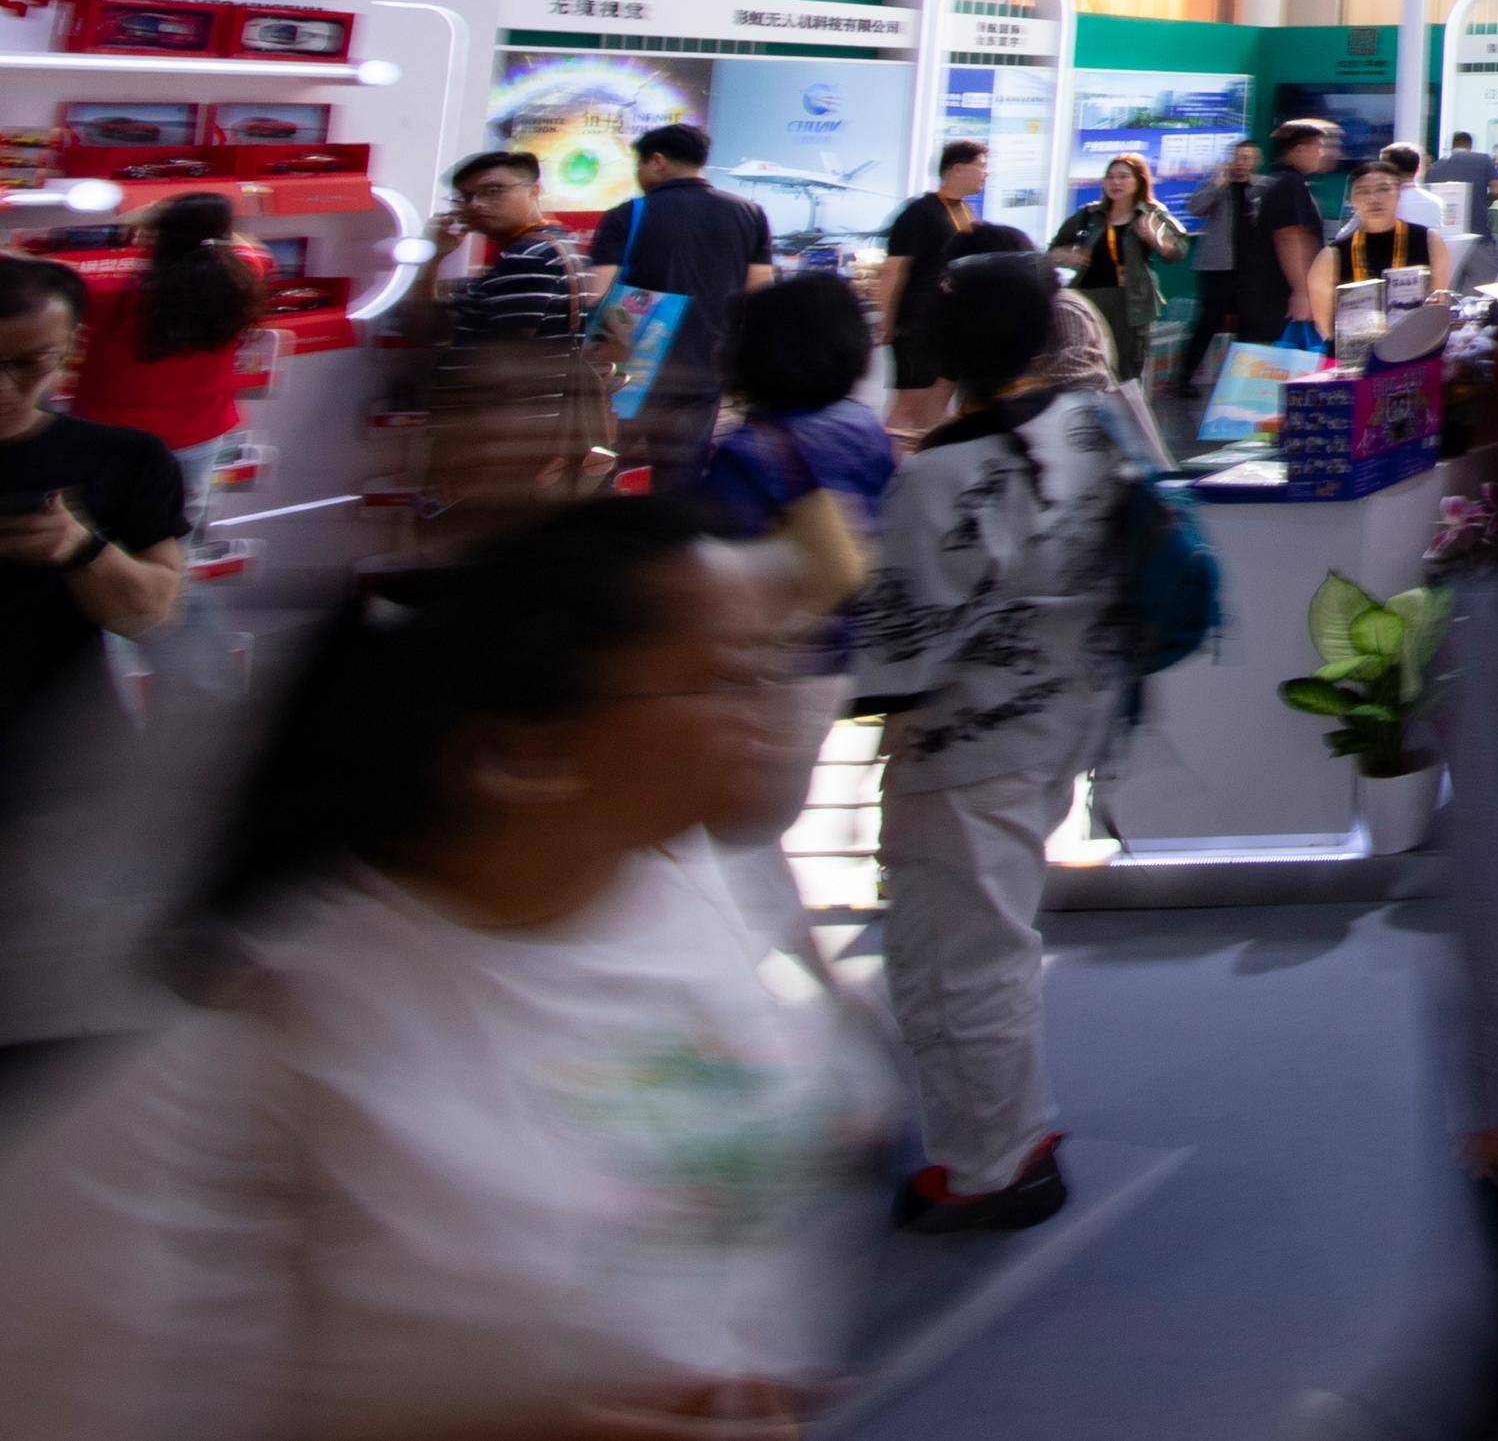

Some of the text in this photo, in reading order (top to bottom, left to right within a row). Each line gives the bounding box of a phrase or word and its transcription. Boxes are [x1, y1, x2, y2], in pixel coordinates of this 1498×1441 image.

[733, 8, 902, 35] 彩虹无人机科技有限公司
